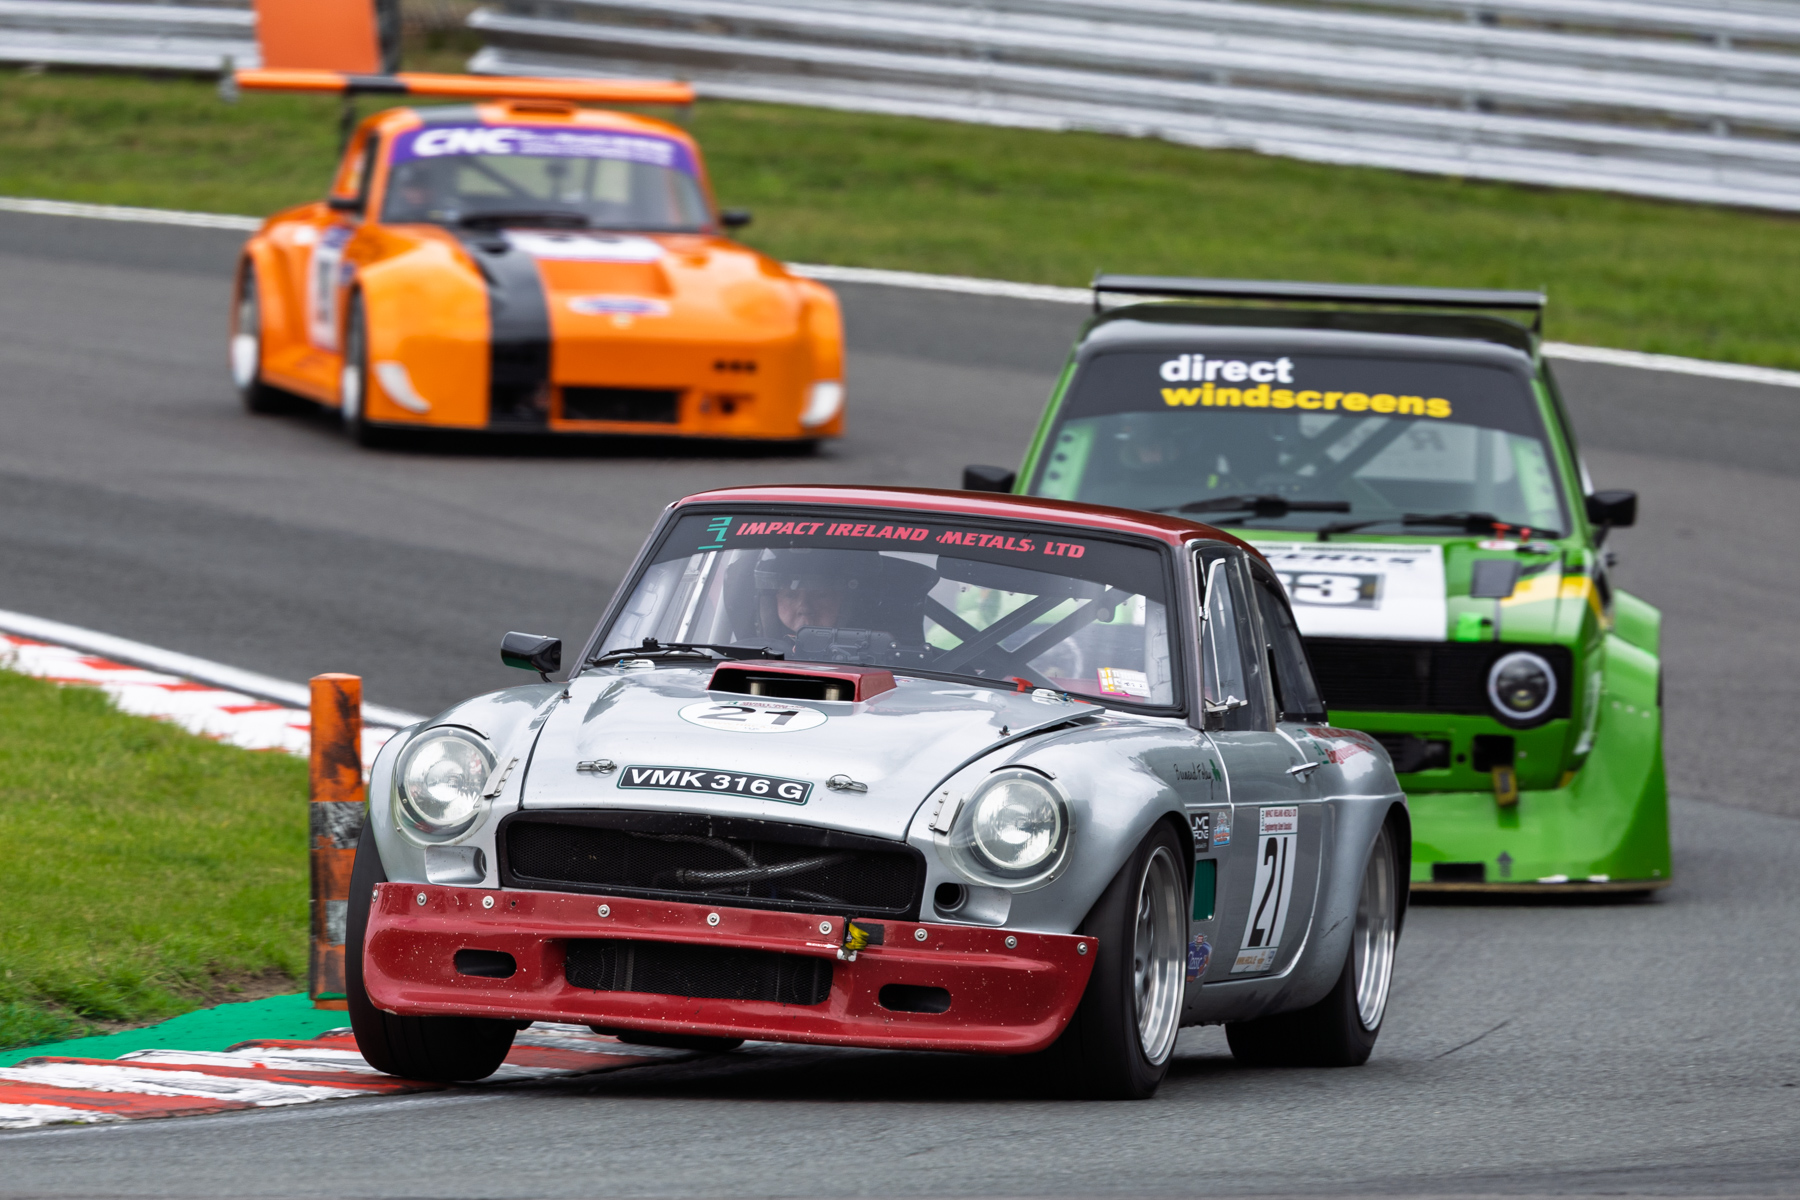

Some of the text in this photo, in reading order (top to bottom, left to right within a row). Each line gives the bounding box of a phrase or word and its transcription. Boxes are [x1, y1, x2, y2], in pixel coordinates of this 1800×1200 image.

[1160, 354, 1294, 383] direct
[1160, 383, 1452, 418] windscreens
[736, 522, 825, 536] IMPACT
[826, 523, 930, 541] IRELAND
[1043, 541, 1086, 558] LTD
[697, 706, 799, 726] 21
[631, 768, 804, 800] VMK 316 G
[1247, 836, 1288, 948] 21
